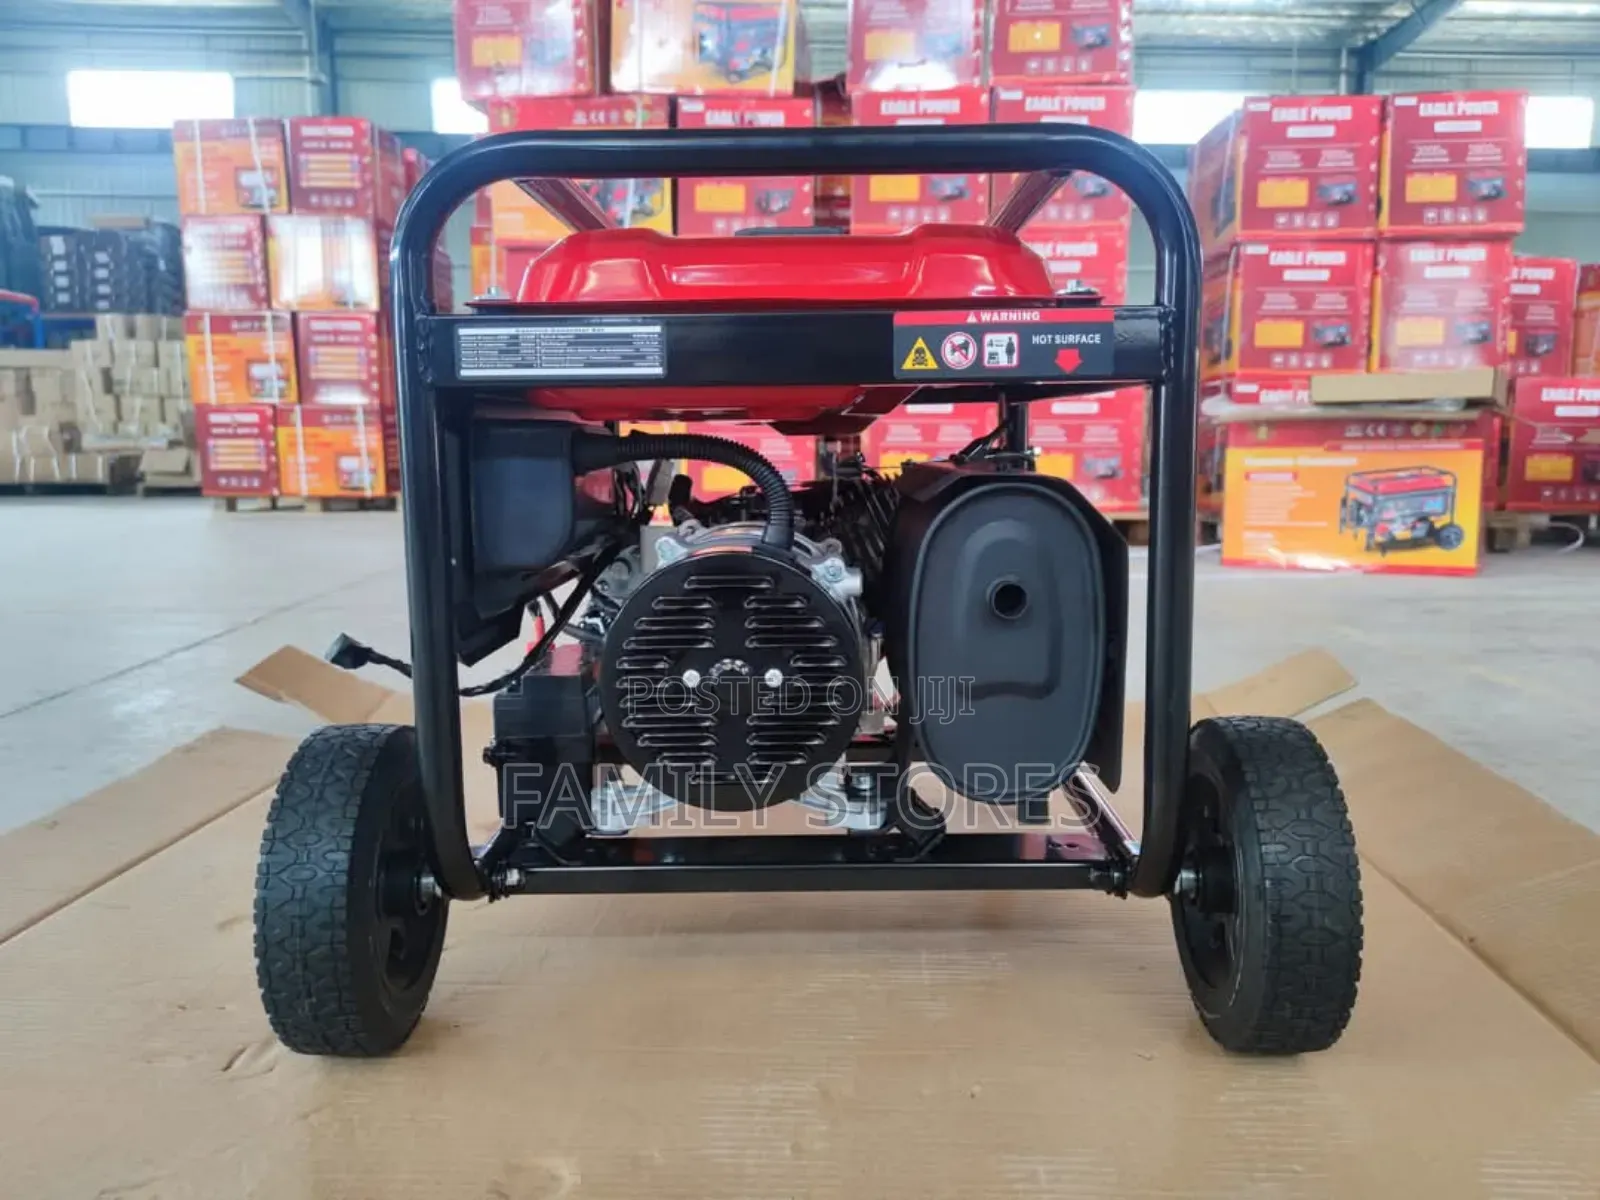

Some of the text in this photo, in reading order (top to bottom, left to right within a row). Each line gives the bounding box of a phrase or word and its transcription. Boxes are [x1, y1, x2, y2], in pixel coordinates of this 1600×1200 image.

[1457, 101, 1498, 116] POWER
[980, 310, 1041, 323] WARNING
[1032, 333, 1102, 345] HOT SURFACE
